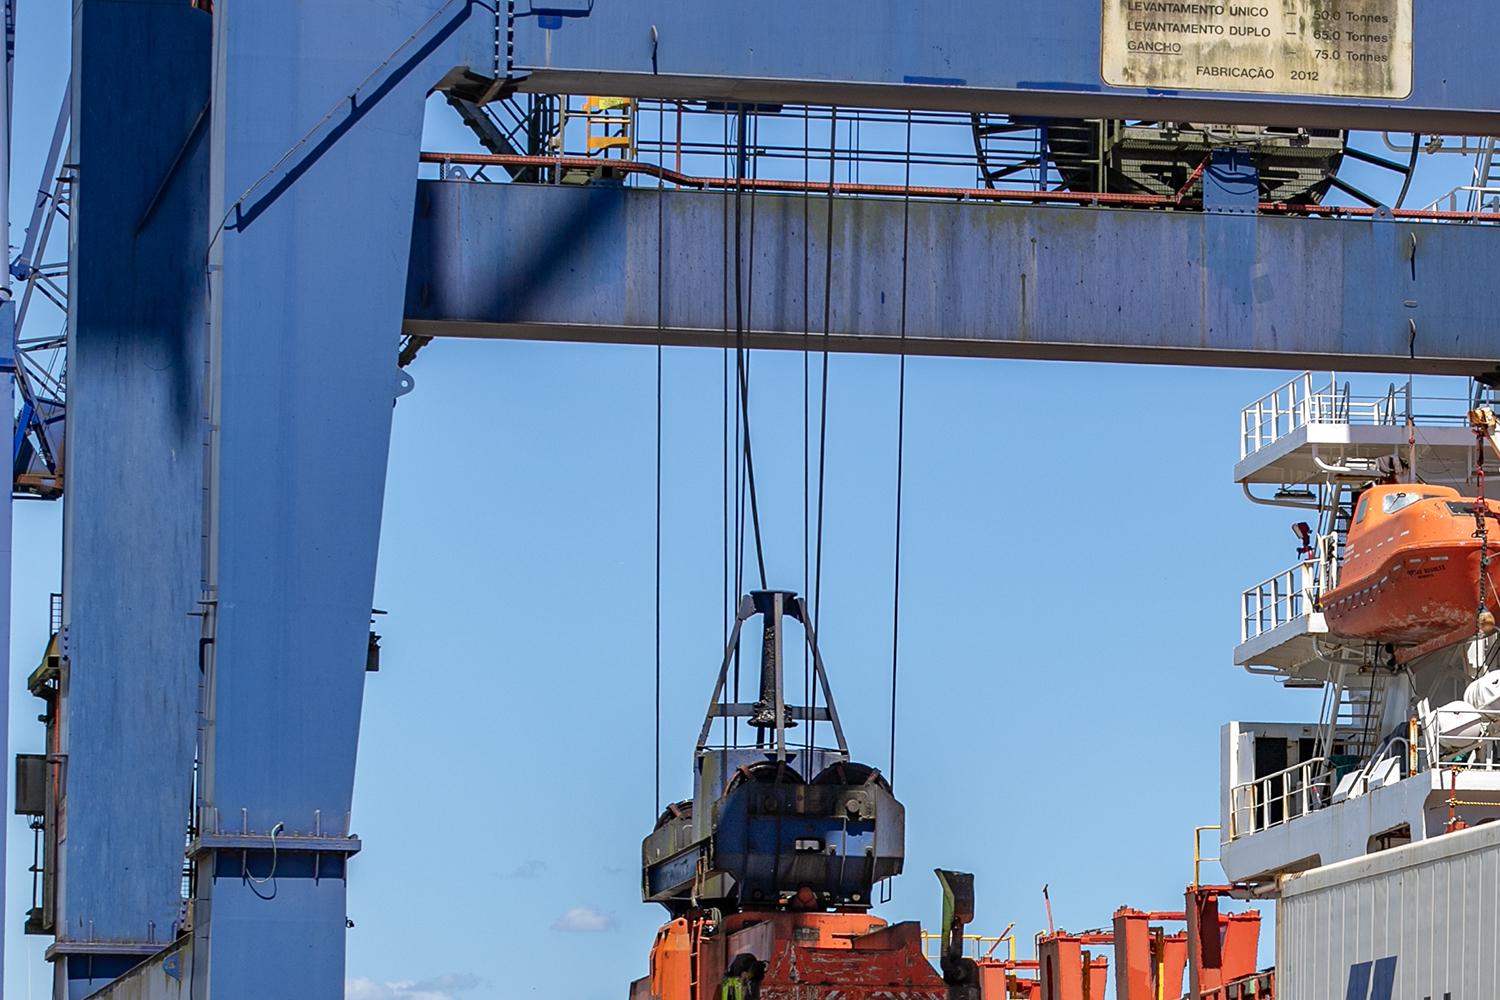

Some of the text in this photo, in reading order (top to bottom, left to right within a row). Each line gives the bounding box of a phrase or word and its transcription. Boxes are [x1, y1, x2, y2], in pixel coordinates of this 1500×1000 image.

[1128, 1, 1388, 23] LEVANTAMENTO ÚNICO 50.0 Tonnes
[1128, 21, 1388, 42] LEVANTAMENTO DUPLO 65.0 Tonnes
[1128, 41, 1388, 62] GANCHO 75.0 Tonnes
[1196, 66, 1319, 81] FABRICAÇÃO 2012
